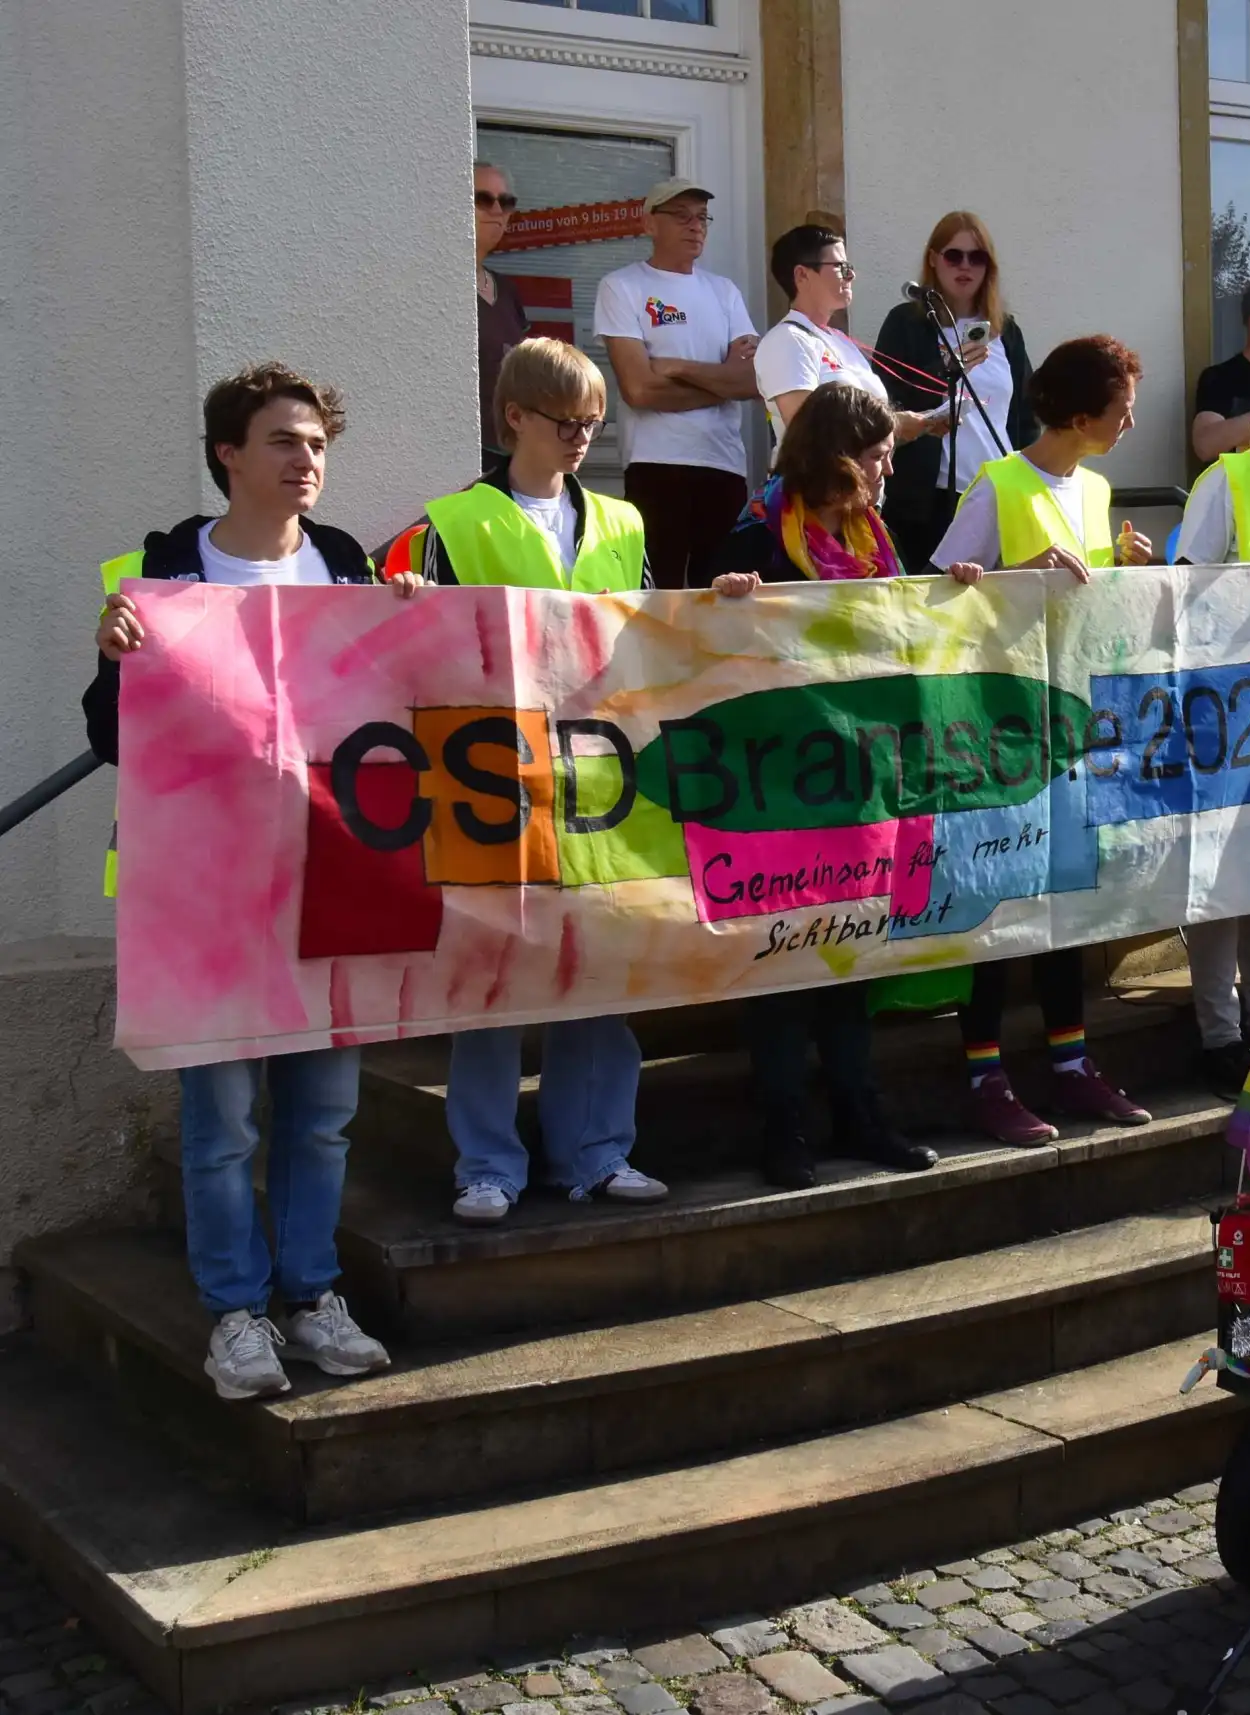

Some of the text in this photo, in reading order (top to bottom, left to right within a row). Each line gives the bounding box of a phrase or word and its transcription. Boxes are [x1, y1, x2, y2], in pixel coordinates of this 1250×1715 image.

[504, 217, 554, 233] eratung
[556, 214, 579, 227] von
[582, 213, 590, 225] 9
[592, 209, 610, 224] bis
[614, 207, 627, 220] 19
[663, 311, 687, 323] QNB
[331, 716, 636, 851] CSD
[659, 692, 1123, 823] Bramsche
[702, 824, 1050, 904] Gemeinsam für mehr
[754, 893, 954, 960] Sichtbarkeit
